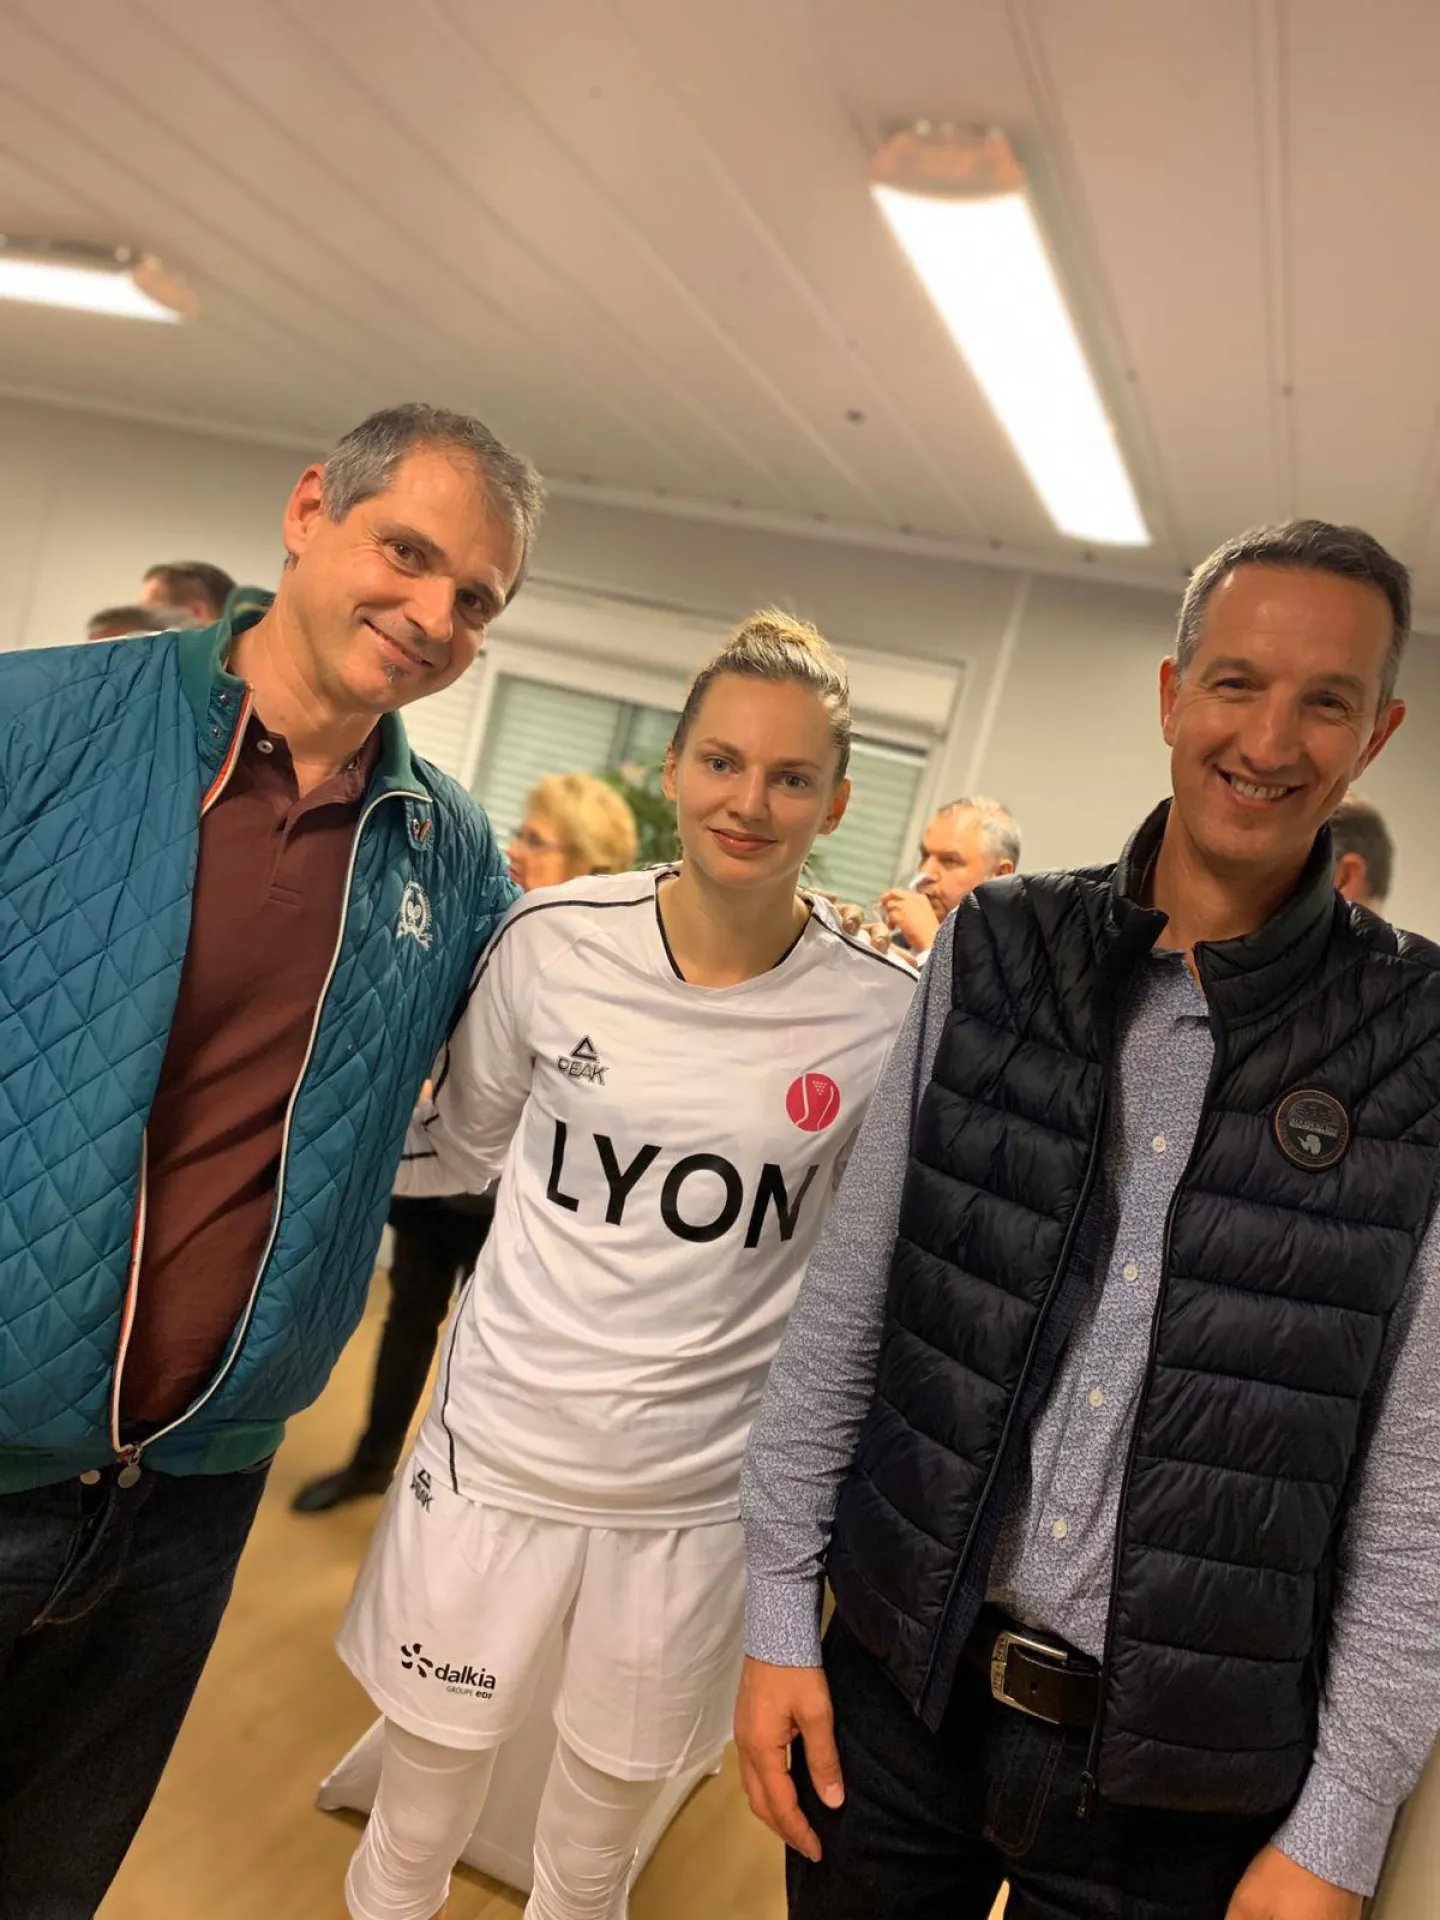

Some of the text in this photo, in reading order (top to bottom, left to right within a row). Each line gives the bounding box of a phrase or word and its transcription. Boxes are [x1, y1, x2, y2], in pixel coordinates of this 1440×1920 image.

[557, 1057, 609, 1086] PEAK
[546, 1119, 819, 1249] LYON
[434, 1663, 497, 1690] dalkia
[445, 1685, 474, 1697] GROUPE
